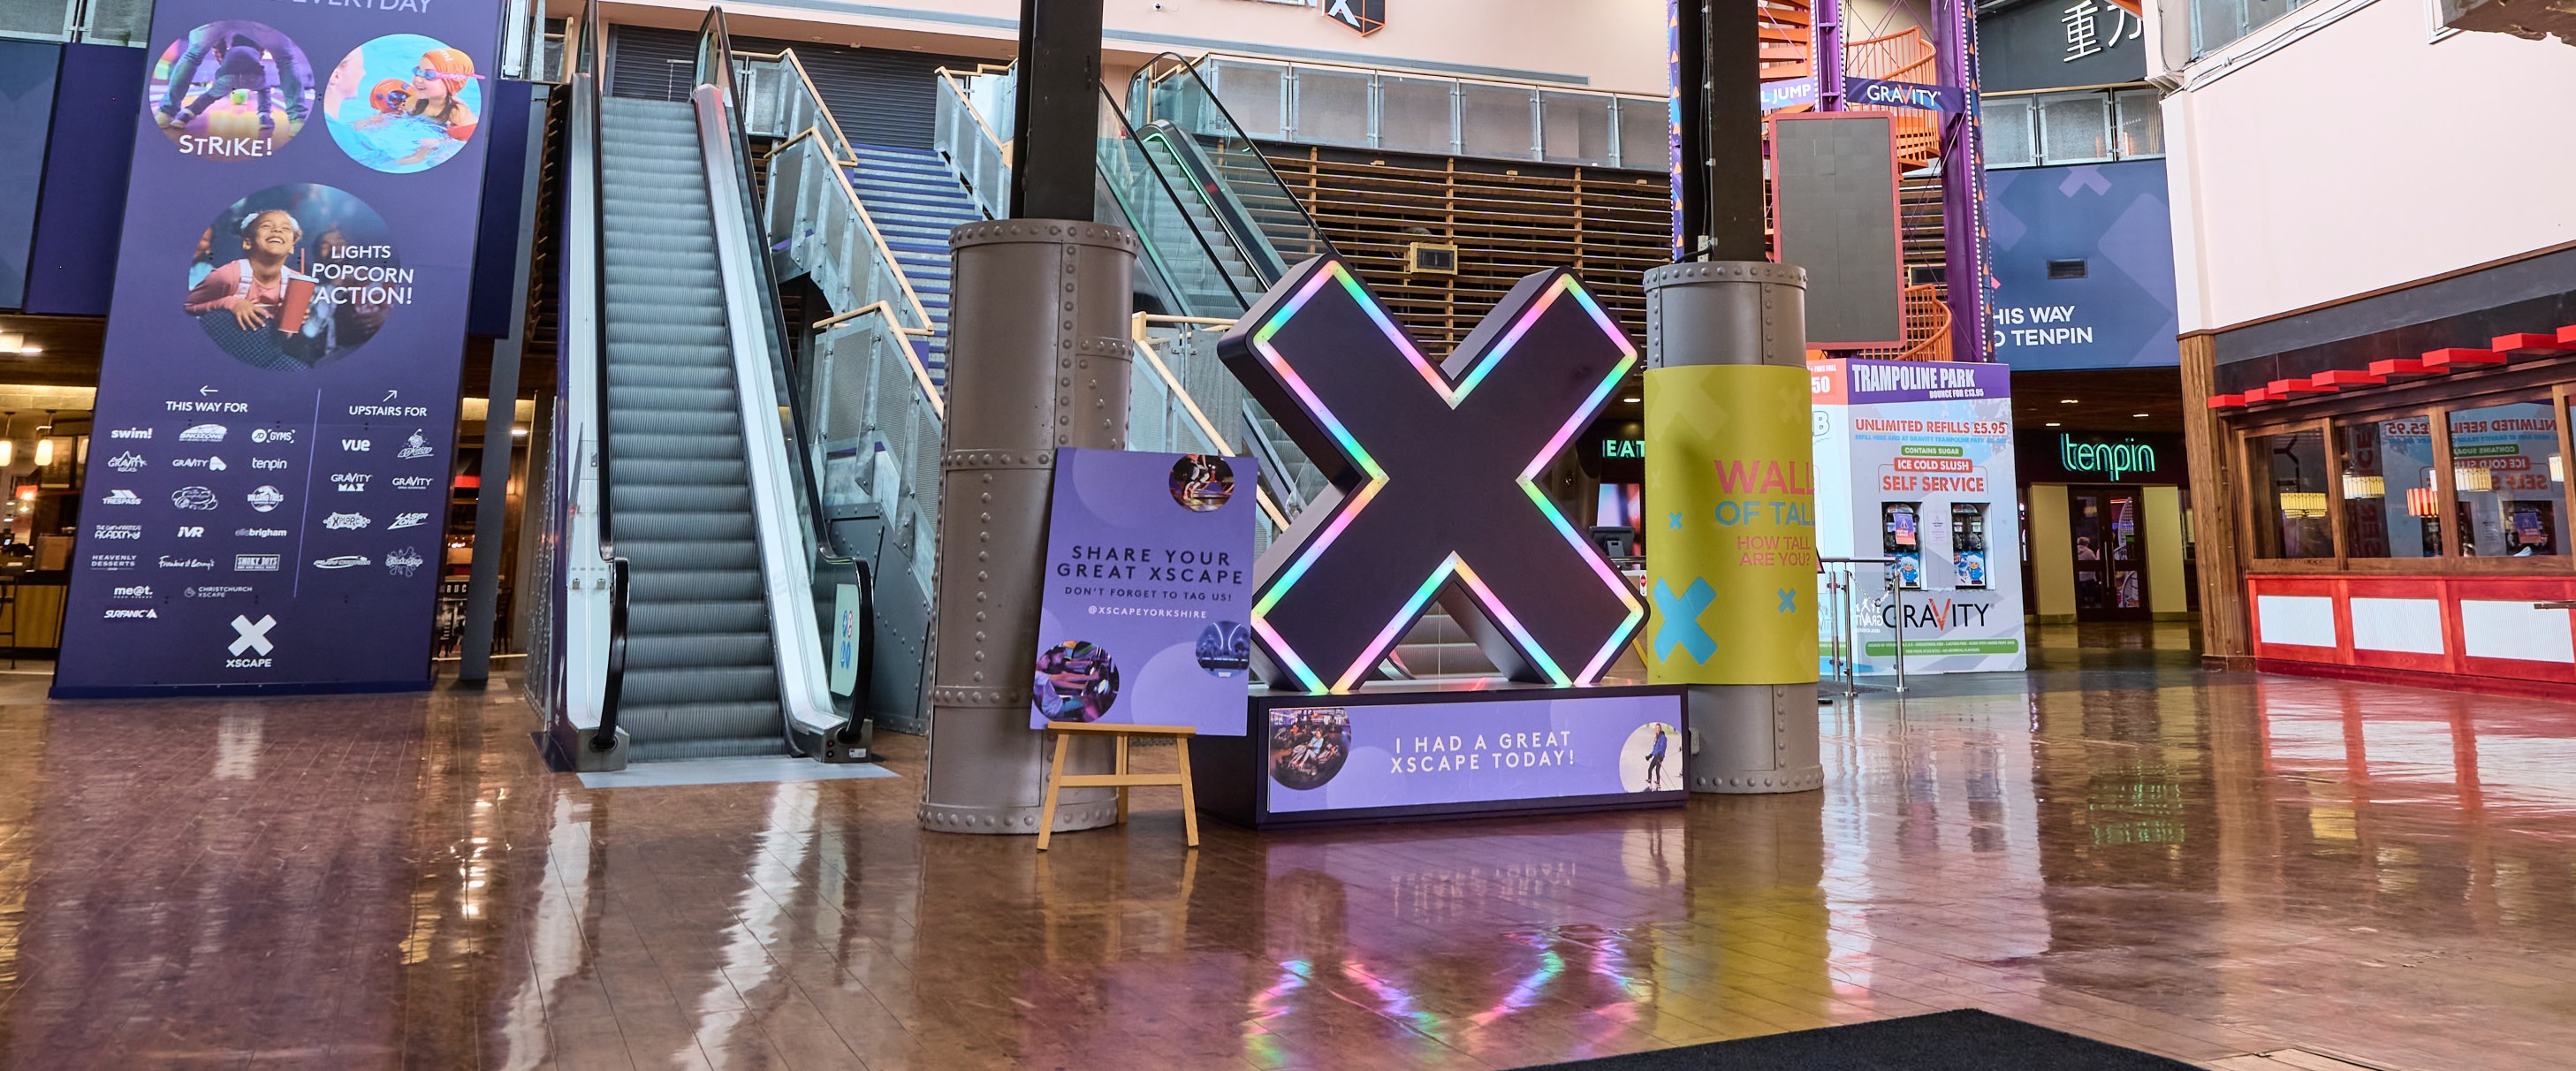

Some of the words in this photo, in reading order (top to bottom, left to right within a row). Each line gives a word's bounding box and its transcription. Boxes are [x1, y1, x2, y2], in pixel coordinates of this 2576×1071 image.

[1772, 83, 1812, 104] JUMP
[1866, 84, 1938, 107] GRAVITY
[179, 134, 273, 158] STRIKE!
[331, 245, 391, 260] LIGHTS
[311, 263, 414, 285] POPCORN
[313, 286, 414, 307] ACTION!
[1993, 308, 2025, 325] HIS
[2029, 305, 2076, 323] WAY
[2010, 326, 2093, 346] TENPIN
[1852, 363, 1938, 392] TRAMPOLINE
[1940, 368, 1976, 389] PARK
[1929, 390, 1952, 399] BOUNCE
[1964, 388, 1985, 398] £13.95
[166, 400, 193, 412] THIS
[195, 401, 222, 413] WAY
[224, 402, 248, 413] FOR
[349, 406, 402, 416] UPSTAIRS
[404, 406, 427, 417] FOR
[110, 427, 153, 439] swim!
[1855, 418, 1923, 432] UNLIMITED
[1926, 420, 1970, 434] REFILLS
[1973, 421, 2006, 434] £5.95
[270, 431, 293, 442] GYMS
[172, 458, 209, 467] GRAVITY
[252, 457, 288, 471] tenpin
[2063, 433, 2156, 481] tenpin
[1897, 460, 1912, 469] ICE
[1914, 460, 1938, 470] COLD
[1940, 460, 1970, 471] SLUSH
[331, 473, 371, 482] GRAVITY
[391, 476, 432, 486] GRAVITY
[1714, 460, 1814, 495] WALL
[1882, 475, 1918, 491] SELF
[1922, 476, 1985, 492] SERVICE
[338, 482, 365, 492] MAX
[1715, 500, 1761, 526] OF
[1736, 536, 1781, 550] HOW
[1783, 536, 1811, 551] TALL
[1072, 544, 1151, 563] SHARE
[1166, 549, 1230, 566] YOUR
[1740, 552, 1775, 566] ARE
[1778, 552, 1811, 566] YOU?
[1057, 562, 1136, 580] GREAT
[1149, 566, 1243, 585] XSCAPE
[1065, 586, 1105, 596] DON'T
[1110, 588, 1158, 599] FORGET
[1163, 590, 1178, 600] TO
[1183, 591, 1206, 601] TAG
[1212, 593, 1233, 602] US!
[1088, 605, 1207, 619] @XSCAPEYORKSHIRE
[1882, 597, 1990, 631] GRAVITY
[226, 658, 272, 668] XSCAPE
[1394, 737, 1402, 754] I
[1415, 735, 1463, 753] HAD
[1474, 733, 1488, 750] A
[1499, 731, 1570, 749] GREAT
[1390, 756, 1481, 774] XSCAPE
[1493, 749, 1576, 769] TODAY!
